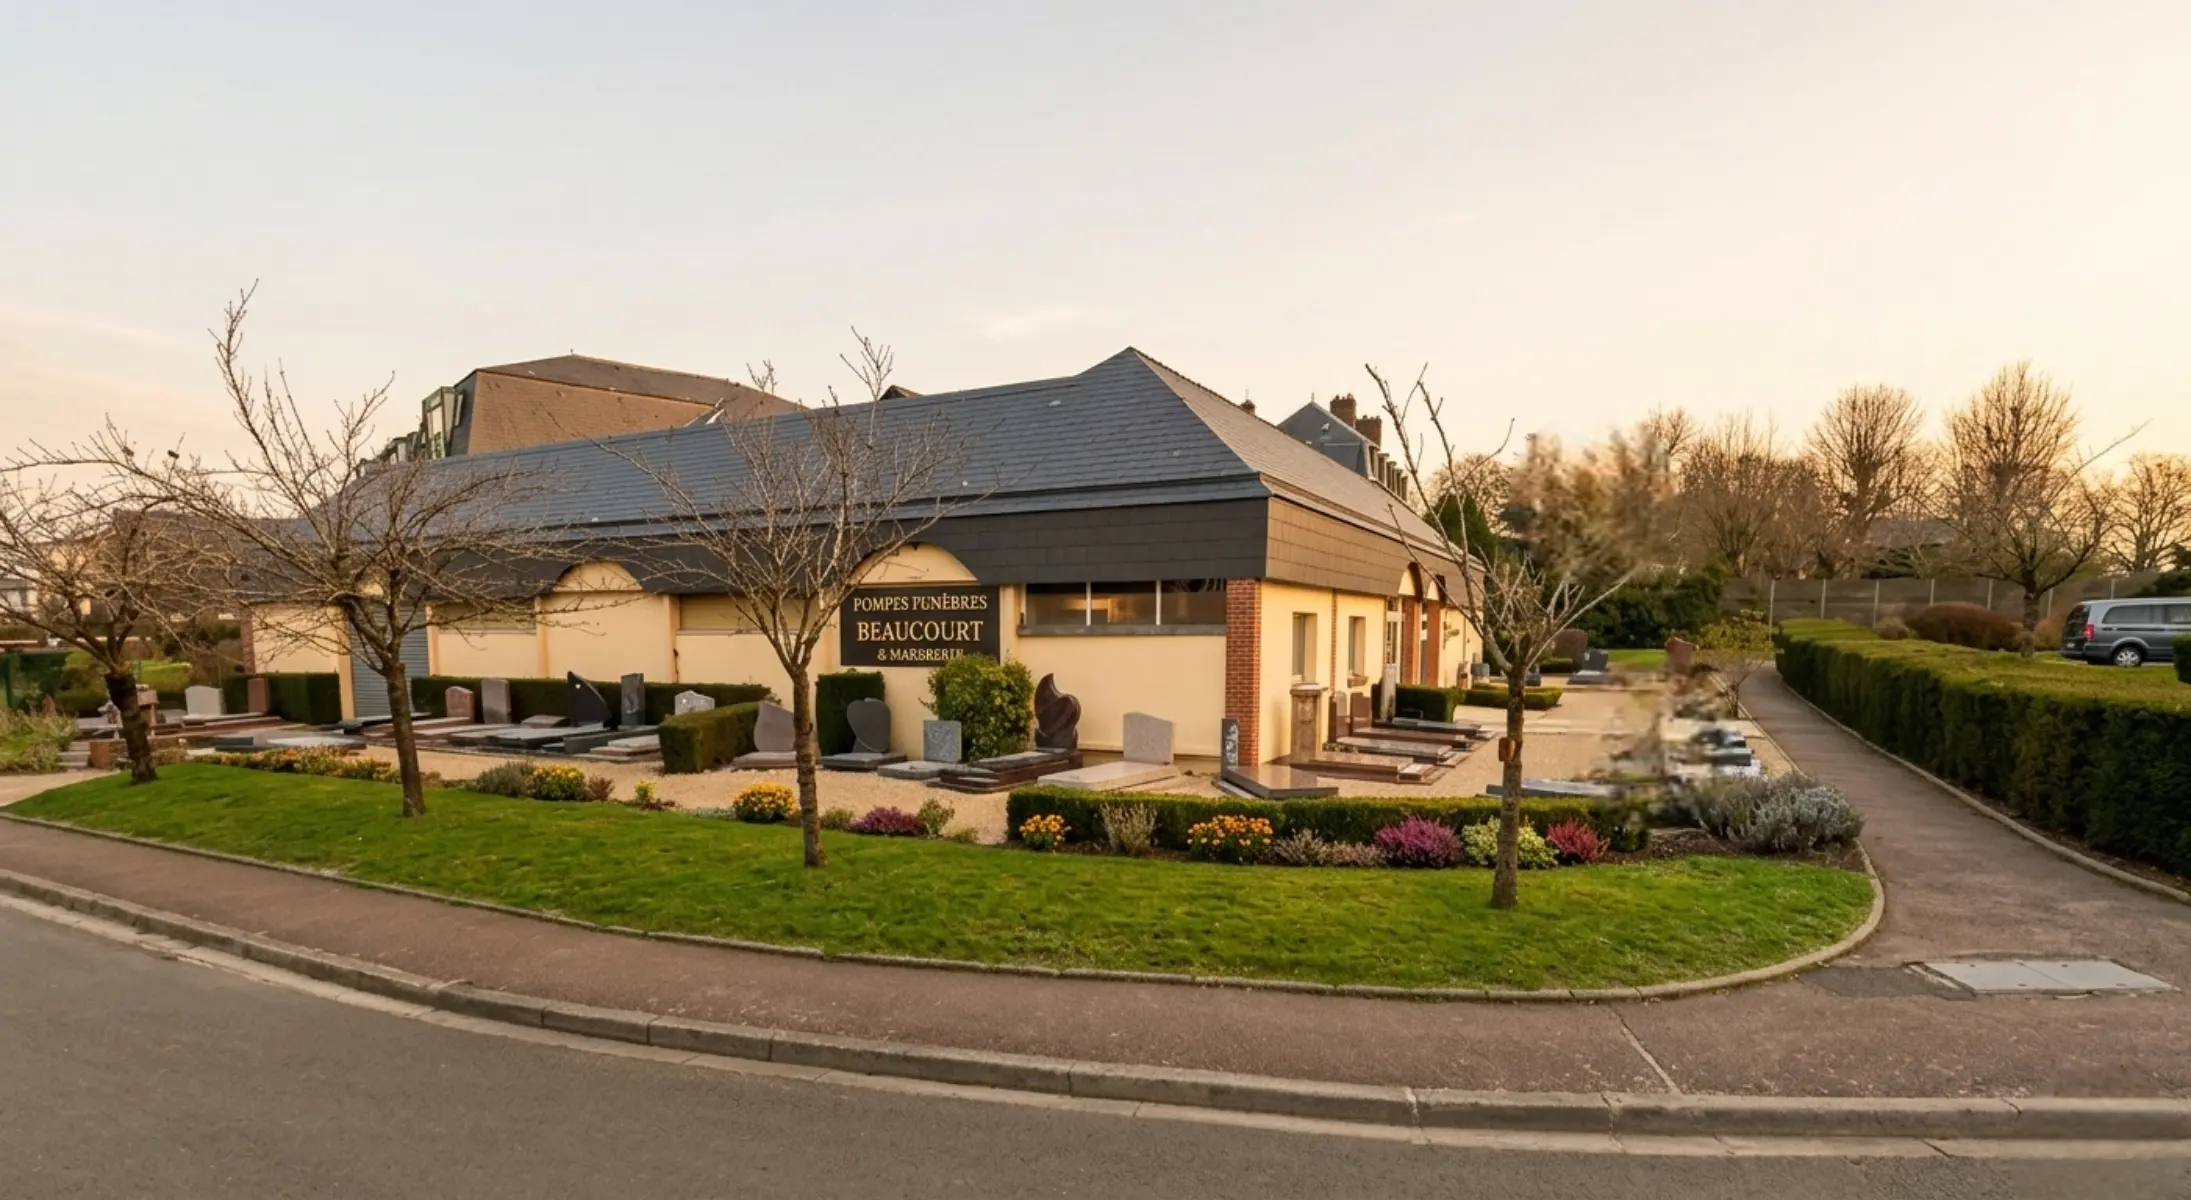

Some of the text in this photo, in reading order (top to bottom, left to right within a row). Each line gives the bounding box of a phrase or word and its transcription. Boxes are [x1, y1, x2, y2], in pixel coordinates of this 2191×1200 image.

[853, 596, 909, 612] POMPES
[856, 620, 984, 642] BEAUCOURT
[877, 648, 887, 661] &
